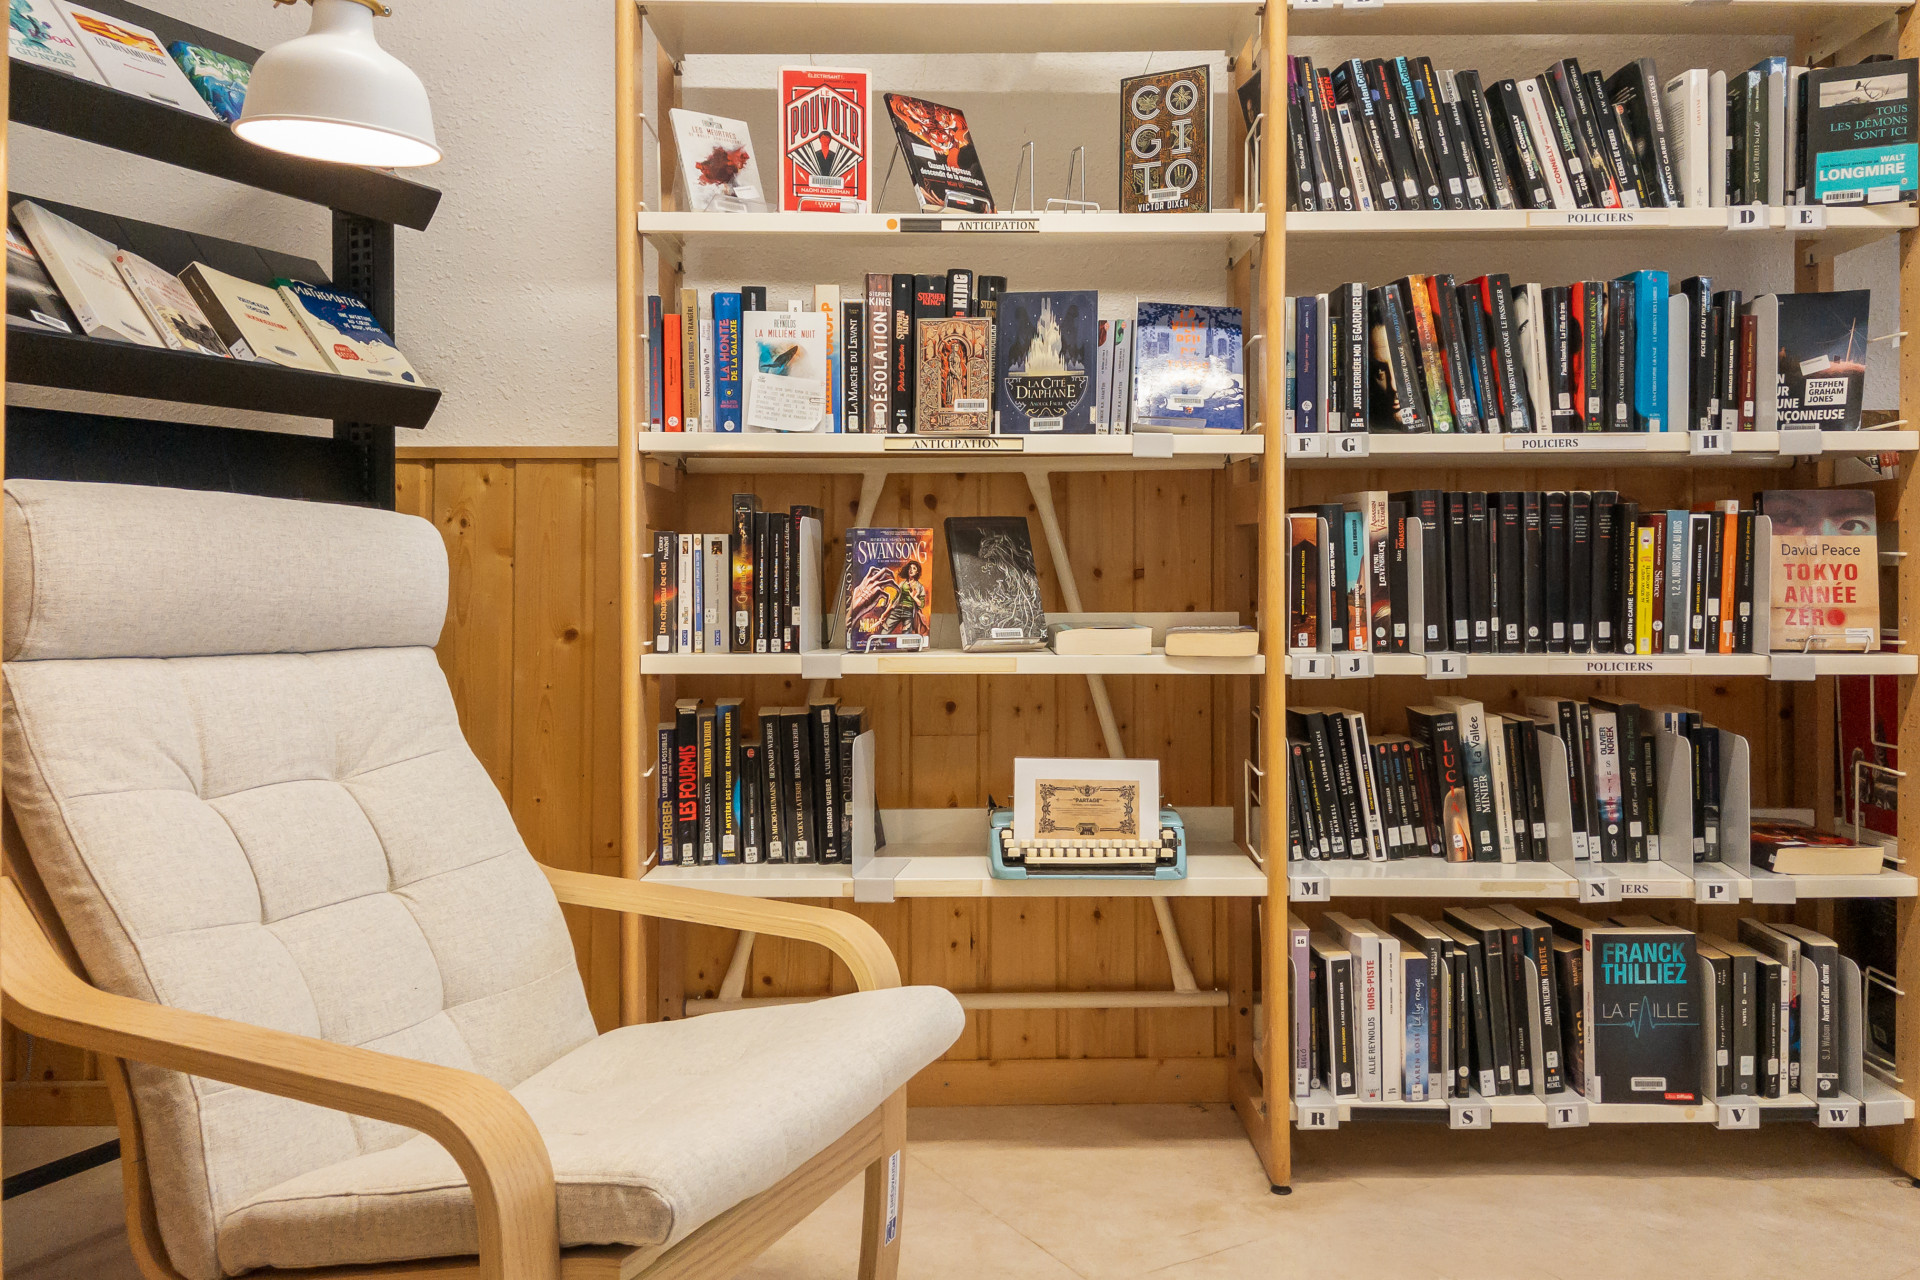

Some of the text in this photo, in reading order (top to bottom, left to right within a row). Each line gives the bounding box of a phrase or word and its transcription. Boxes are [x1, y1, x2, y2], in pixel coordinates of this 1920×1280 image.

[1323, 77, 1336, 109] COBEN
[1876, 104, 1908, 115] TOUS
[791, 93, 860, 148] POUVOIR
[1830, 115, 1908, 132] LES DÉMONS
[1512, 115, 1527, 150] CONNELLY
[1854, 127, 1908, 141] SONT ICI
[1522, 150, 1537, 180] MICHAEL
[1544, 146, 1563, 185] CONNELLY
[1659, 137, 1674, 195] DONATO CARRISI
[1880, 154, 1906, 163] WALT
[1820, 162, 1906, 182] LONGMIRE
[1138, 200, 1189, 212] VICTOR DIXEN
[1568, 213, 1634, 223] POLICIERS
[1740, 210, 1755, 224] D
[1800, 210, 1813, 223] E
[958, 221, 1035, 230] ANTICIPATION
[294, 286, 366, 308] MATHEMATICA
[918, 293, 945, 302] STEPHEN
[953, 274, 968, 308] KING
[869, 297, 891, 306] KING
[1497, 289, 1507, 319] PASSAGER
[1353, 296, 1362, 334] GARDNER
[774, 320, 796, 328] REYNOLDS
[755, 330, 763, 338] LA
[801, 330, 815, 338] NUIT
[720, 319, 730, 381] LA HONTE
[731, 353, 737, 366] LA
[848, 319, 858, 414] LA MARCHE DU LEVANT
[870, 311, 887, 413] DÉSOLATION
[731, 369, 738, 381] DE
[1028, 378, 1066, 388] LA CITÉ
[1353, 344, 1361, 409] JUSTE DERRIÈRE MOI
[1016, 384, 1075, 399] DIAPHANE
[1808, 395, 1834, 403] JONES
[912, 439, 999, 449] ANTICIPATION
[1299, 438, 1311, 451] F
[1342, 438, 1355, 452] G
[1522, 439, 1578, 448] POLICIERS
[1704, 435, 1717, 448] H
[1782, 544, 1860, 556] David Peace
[1379, 541, 1387, 586] LŒVENBRUCK
[1673, 544, 1681, 577] NOUS IRONS
[1784, 564, 1858, 581] TOKYO
[1785, 582, 1857, 604] ANNÉE
[1309, 660, 1317, 673] I
[1350, 659, 1360, 672] J
[1442, 659, 1454, 672] L
[1587, 662, 1653, 671] POLICIERS
[1471, 716, 1482, 765] La Vallée
[1321, 760, 1330, 782] LIONNE
[1442, 740, 1460, 813] LUCIA
[679, 745, 696, 821] LES FOURMIS
[1473, 777, 1482, 812] BERNARD
[1482, 775, 1491, 813] MINIER
[663, 800, 672, 846] WERBER
[1330, 803, 1340, 832] MANKELL
[1350, 801, 1360, 832] MANKELL
[1301, 882, 1319, 895] M
[1591, 883, 1605, 897] N
[1709, 885, 1724, 899] P
[1602, 942, 1687, 963] FRANCK
[1601, 963, 1687, 985] THILLIEZ
[1366, 960, 1375, 1011] HORS-PISTE
[1415, 978, 1424, 1001] rouge
[1821, 964, 1830, 1022] Avant d'aller dormir
[1541, 978, 1553, 1026] JOHAN THEORIN
[1602, 996, 1689, 1018] LA FAILLE
[1368, 1017, 1376, 1055] REYNOLDS
[1822, 1025, 1830, 1046] Watson
[1311, 1112, 1325, 1125] R
[1462, 1110, 1473, 1124] S
[1558, 1109, 1572, 1122] T
[1732, 1109, 1746, 1122] V
[1829, 1110, 1848, 1122] W
